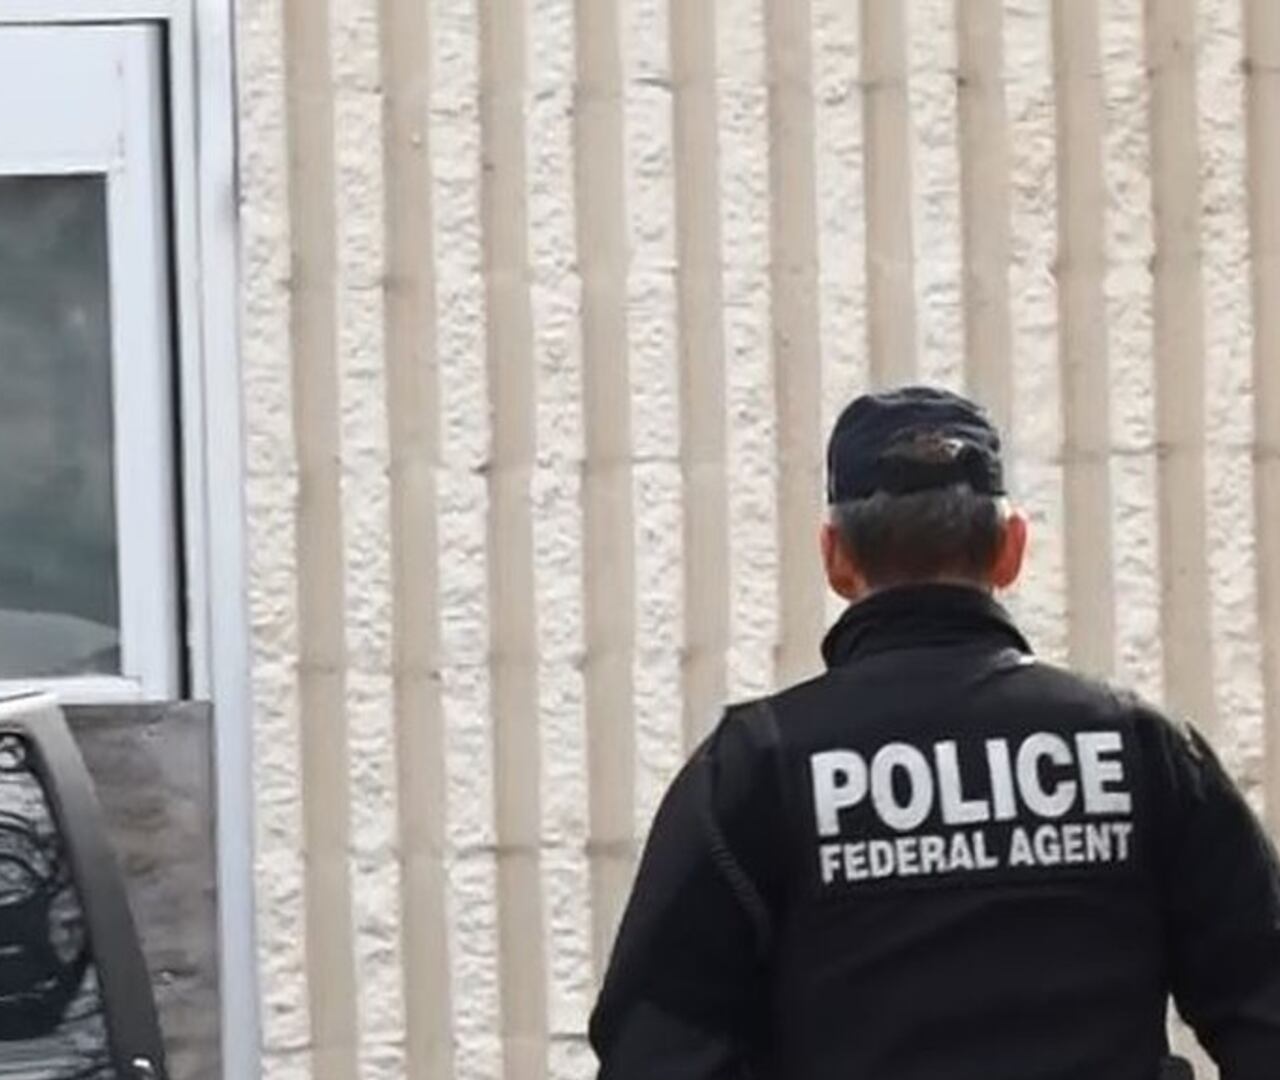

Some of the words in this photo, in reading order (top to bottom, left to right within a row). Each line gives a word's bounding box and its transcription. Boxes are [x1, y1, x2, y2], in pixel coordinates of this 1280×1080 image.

[810, 731, 1132, 837] POLICE
[819, 830, 999, 884] FEDERAL
[1009, 822, 1133, 867] AGENT
